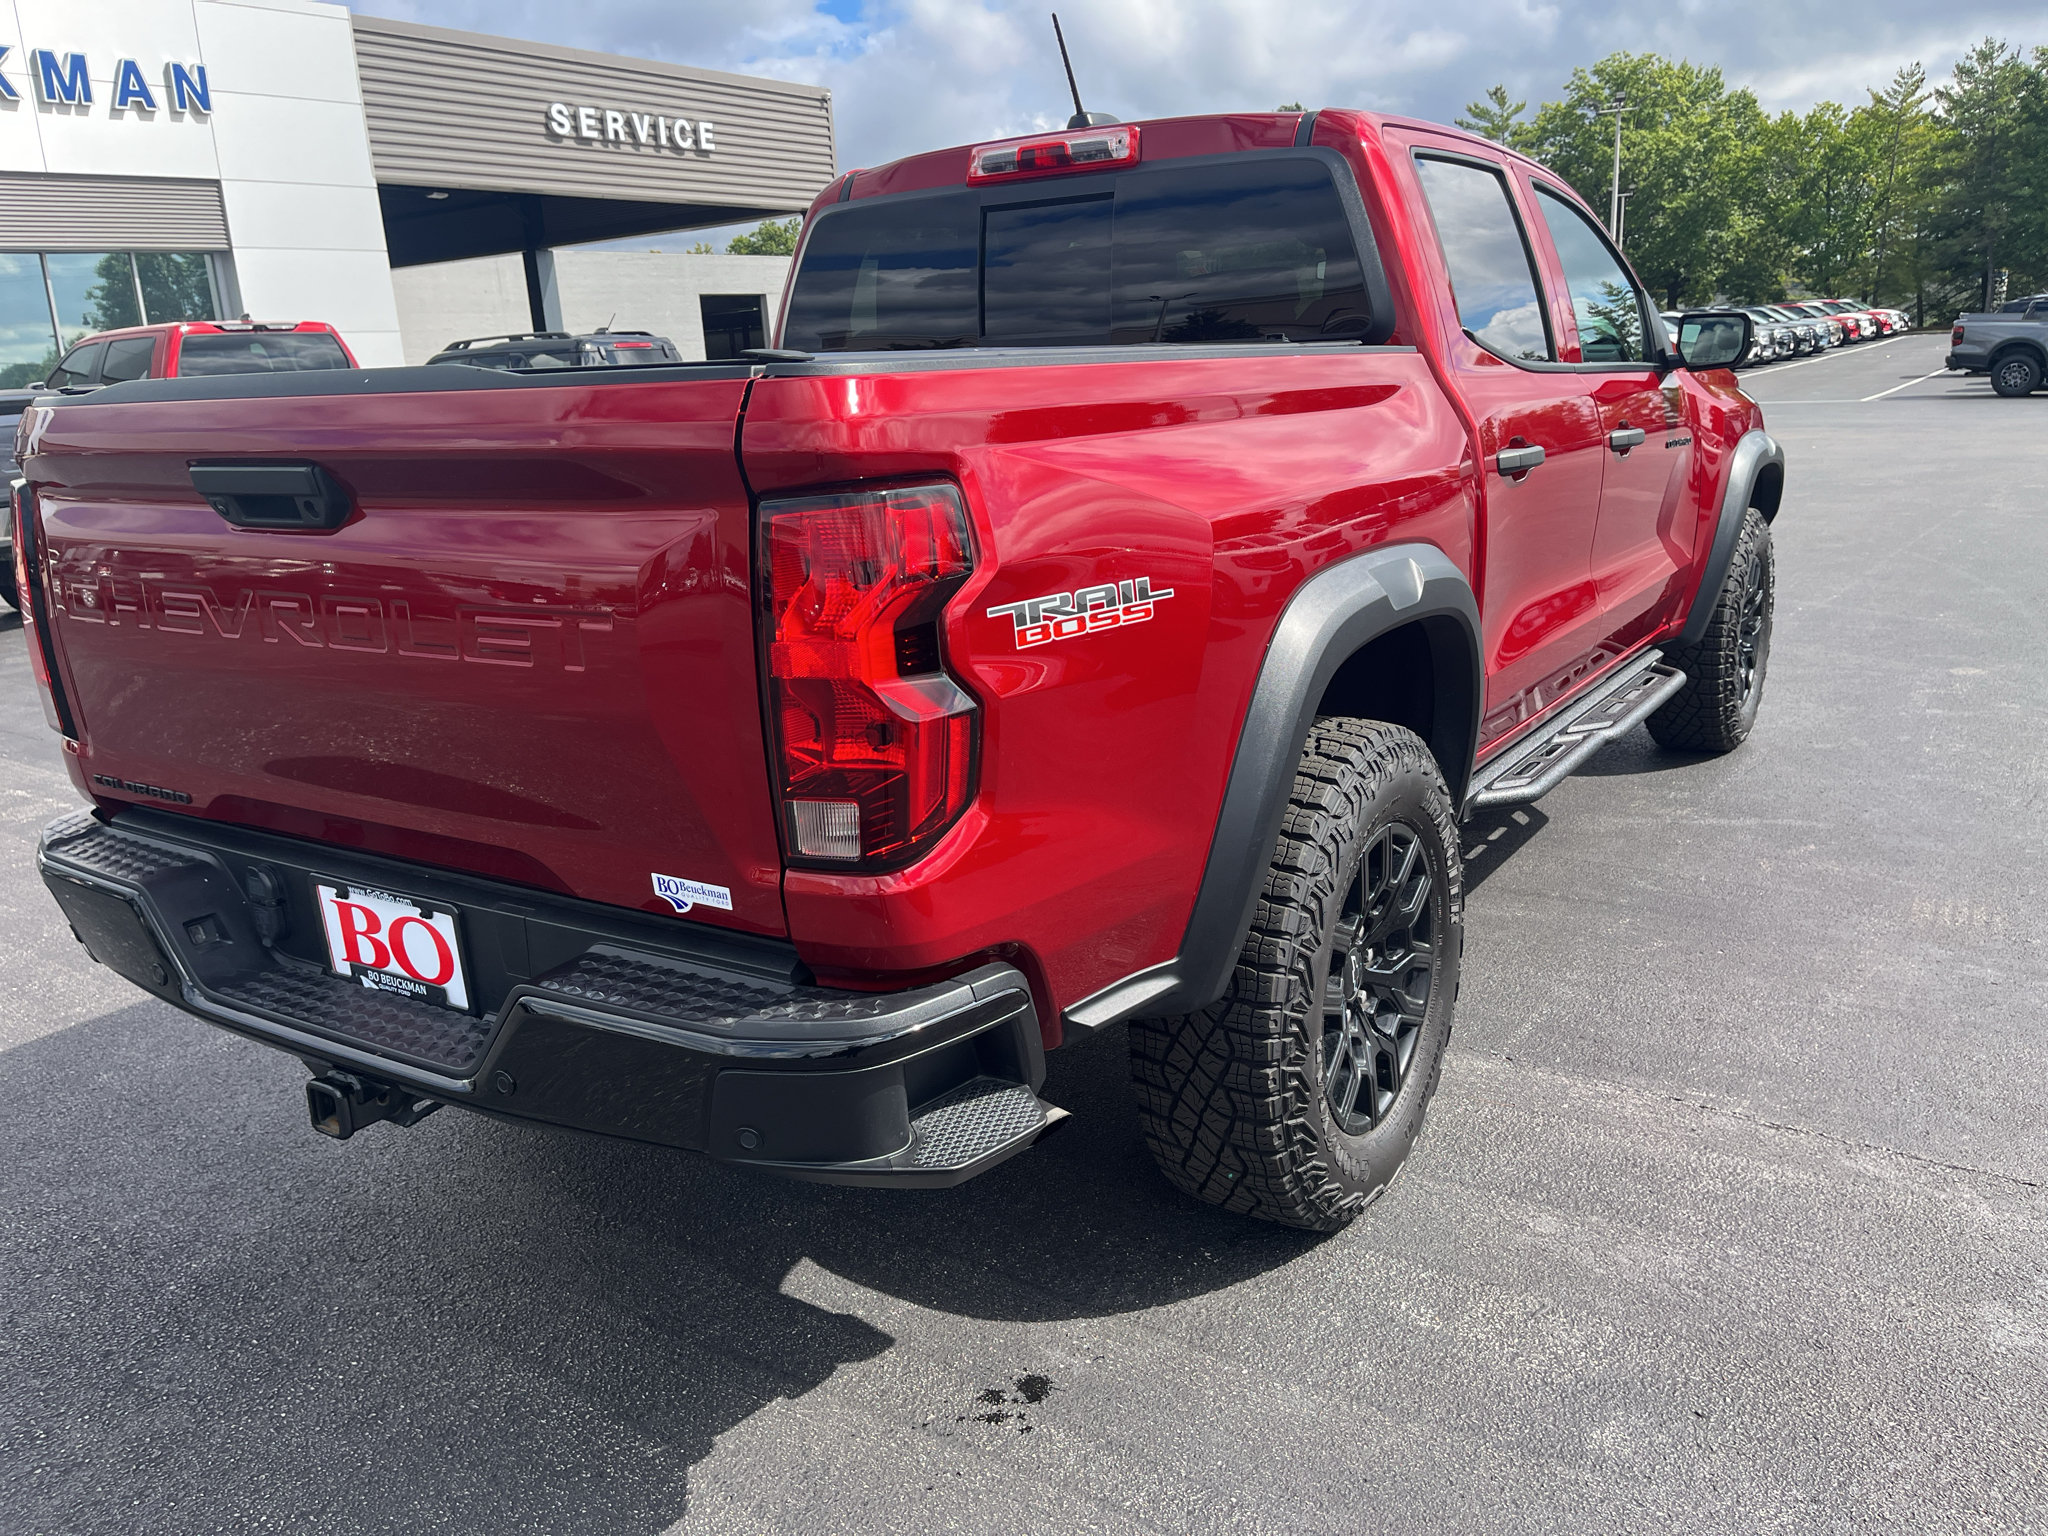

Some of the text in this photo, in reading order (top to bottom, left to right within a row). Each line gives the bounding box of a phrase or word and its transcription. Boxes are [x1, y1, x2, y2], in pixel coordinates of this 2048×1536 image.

[546, 102, 716, 151] SERVICE
[65, 576, 613, 671] CHEVROLET
[987, 576, 1175, 628] TRAIL
[1015, 601, 1155, 650] BOSS
[1420, 785, 1461, 925] WRANGLER
[656, 876, 729, 901] BO Beuckman
[330, 899, 454, 986] BO
[367, 970, 427, 995] BO BEUCKMAN
